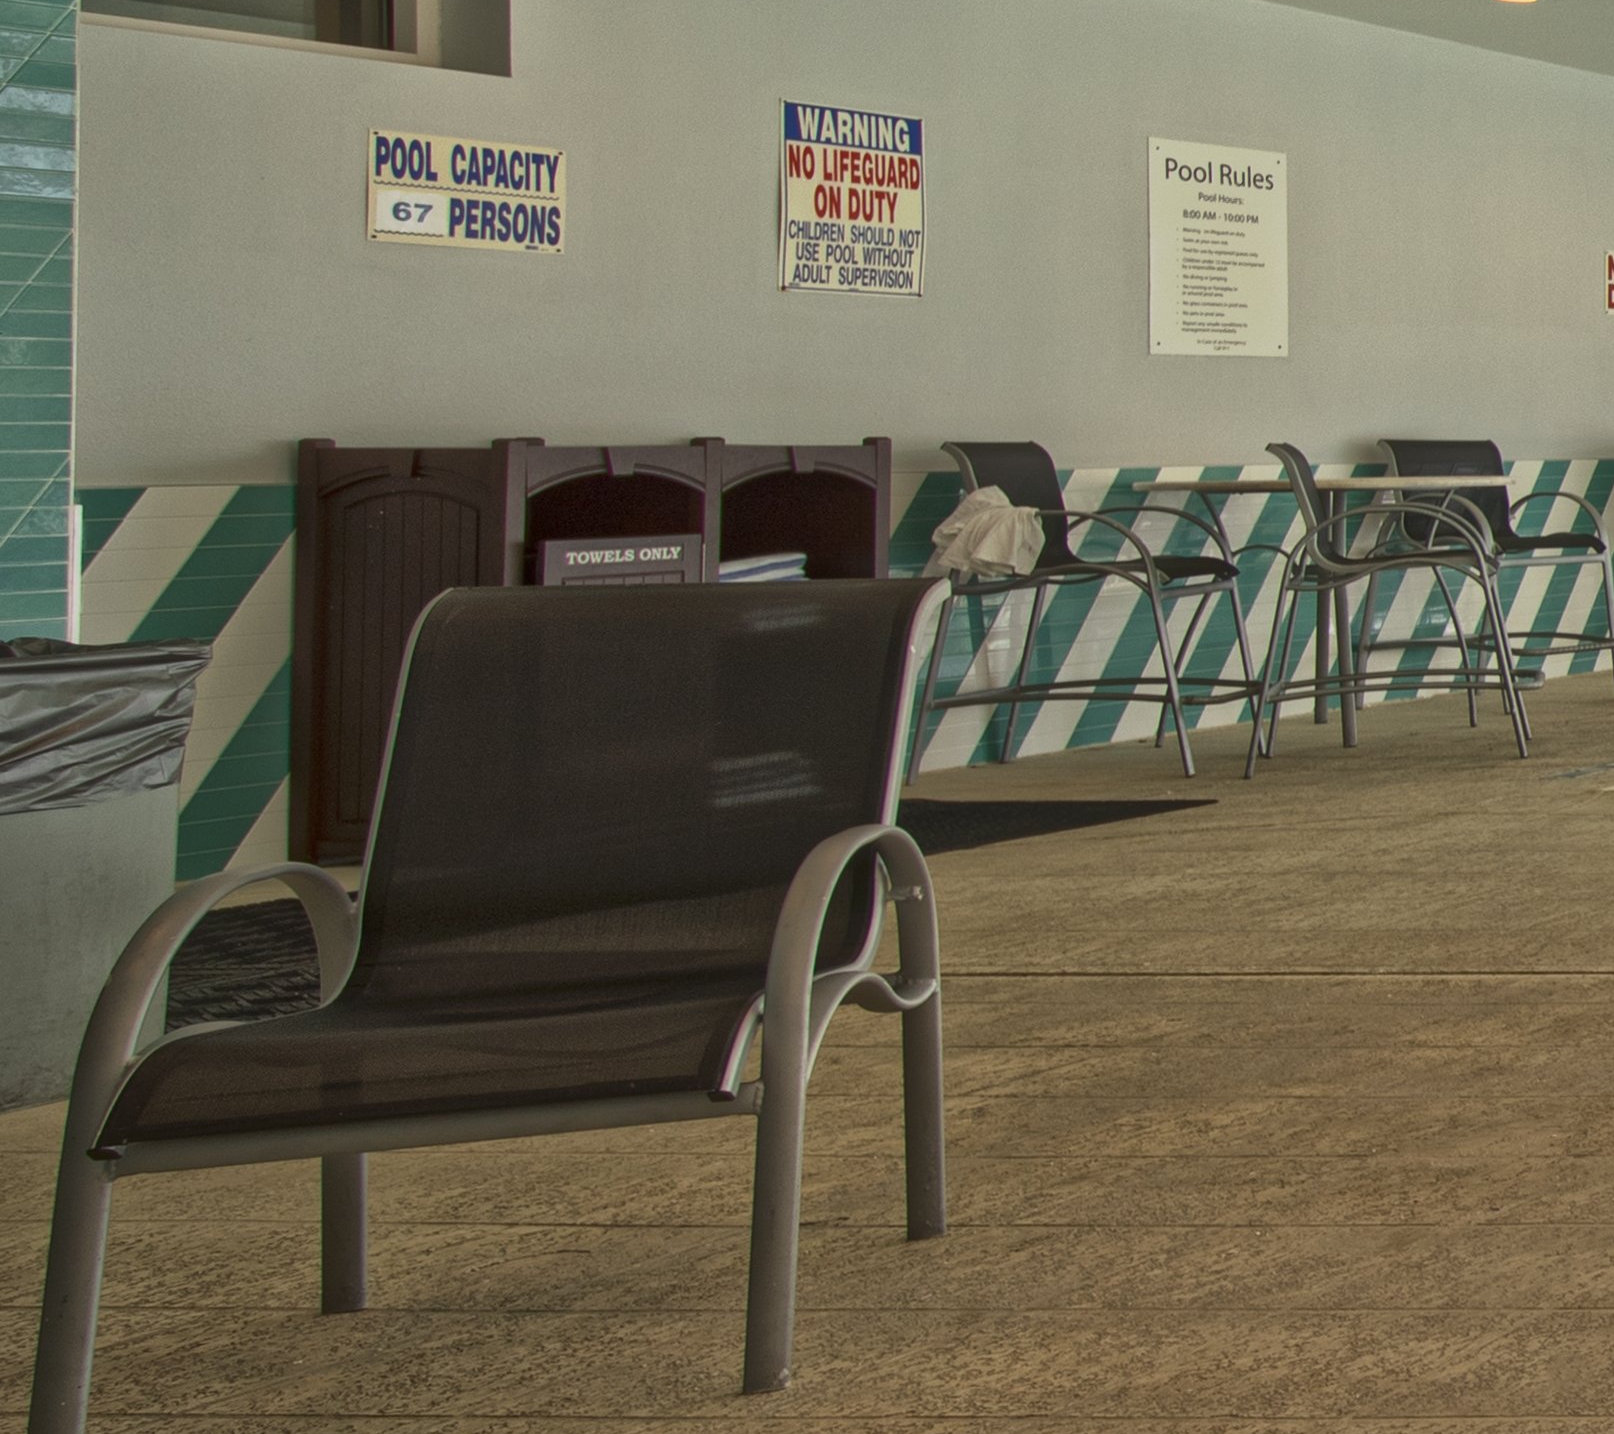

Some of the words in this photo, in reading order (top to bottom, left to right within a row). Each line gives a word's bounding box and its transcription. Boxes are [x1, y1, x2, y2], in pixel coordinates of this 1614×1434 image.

[797, 106, 910, 153] WARNING
[375, 136, 438, 182] POOL
[451, 144, 560, 193] CAPACITY
[788, 144, 815, 180] NO
[823, 148, 921, 190] LIFEGUARD
[1165, 157, 1212, 184] Pool
[1220, 163, 1274, 190] Rules
[814, 184, 841, 219] ON
[848, 187, 898, 224] DUTY
[1198, 192, 1217, 203] Pool
[392, 201, 434, 224] 67
[449, 197, 561, 246] PERSONS
[1183, 209, 1201, 220] 8:00
[1202, 211, 1217, 221] AM
[1224, 213, 1245, 223] 10:00
[1246, 215, 1259, 224] PM
[788, 220, 845, 243] CHILDREN
[851, 225, 895, 246] SHOULD
[900, 230, 921, 249] NOT
[796, 241, 819, 262] USE
[826, 244, 858, 265] POOL
[863, 247, 914, 268] WITHOUT
[793, 263, 832, 284] ADULT
[838, 267, 913, 289] SUPERVISION
[566, 549, 635, 565] TOWELS
[639, 546, 681, 560] ONLY
